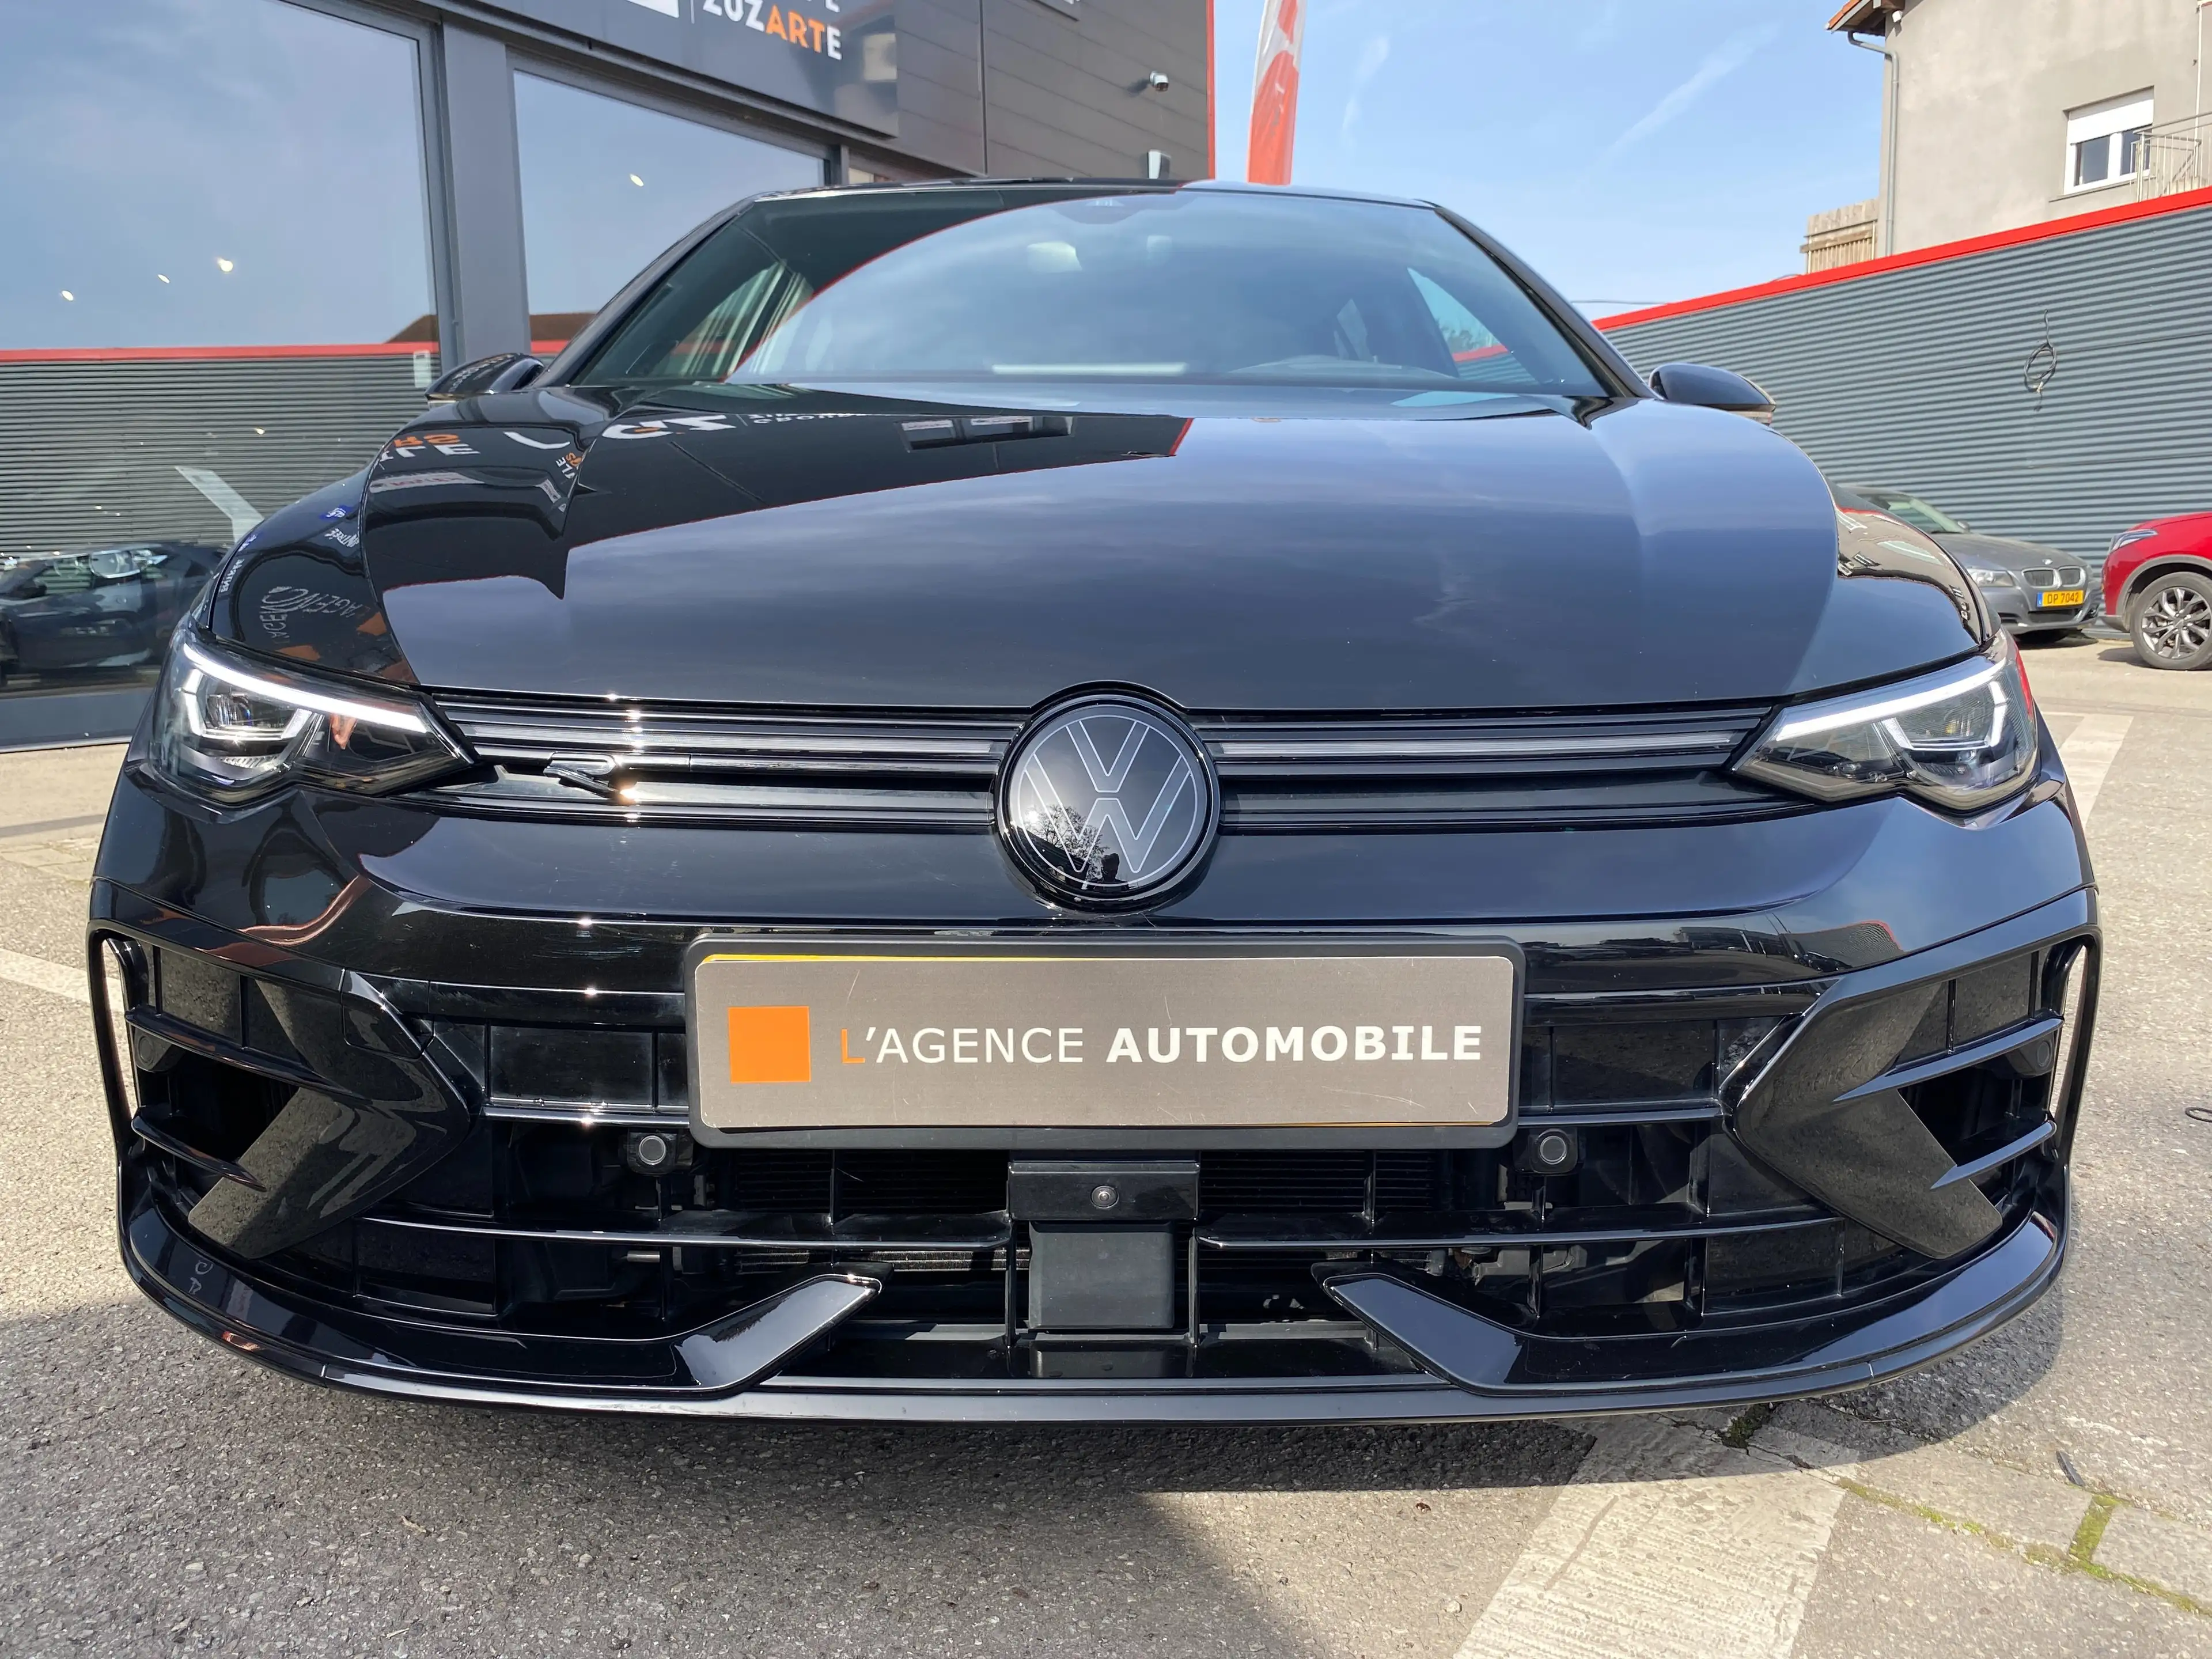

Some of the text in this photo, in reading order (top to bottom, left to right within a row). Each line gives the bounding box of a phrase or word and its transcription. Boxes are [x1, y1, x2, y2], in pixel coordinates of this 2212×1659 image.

[2047, 592, 2079, 604] DP 7042
[840, 1024, 1482, 1064] L'AGENCE AUTOMOBILE
